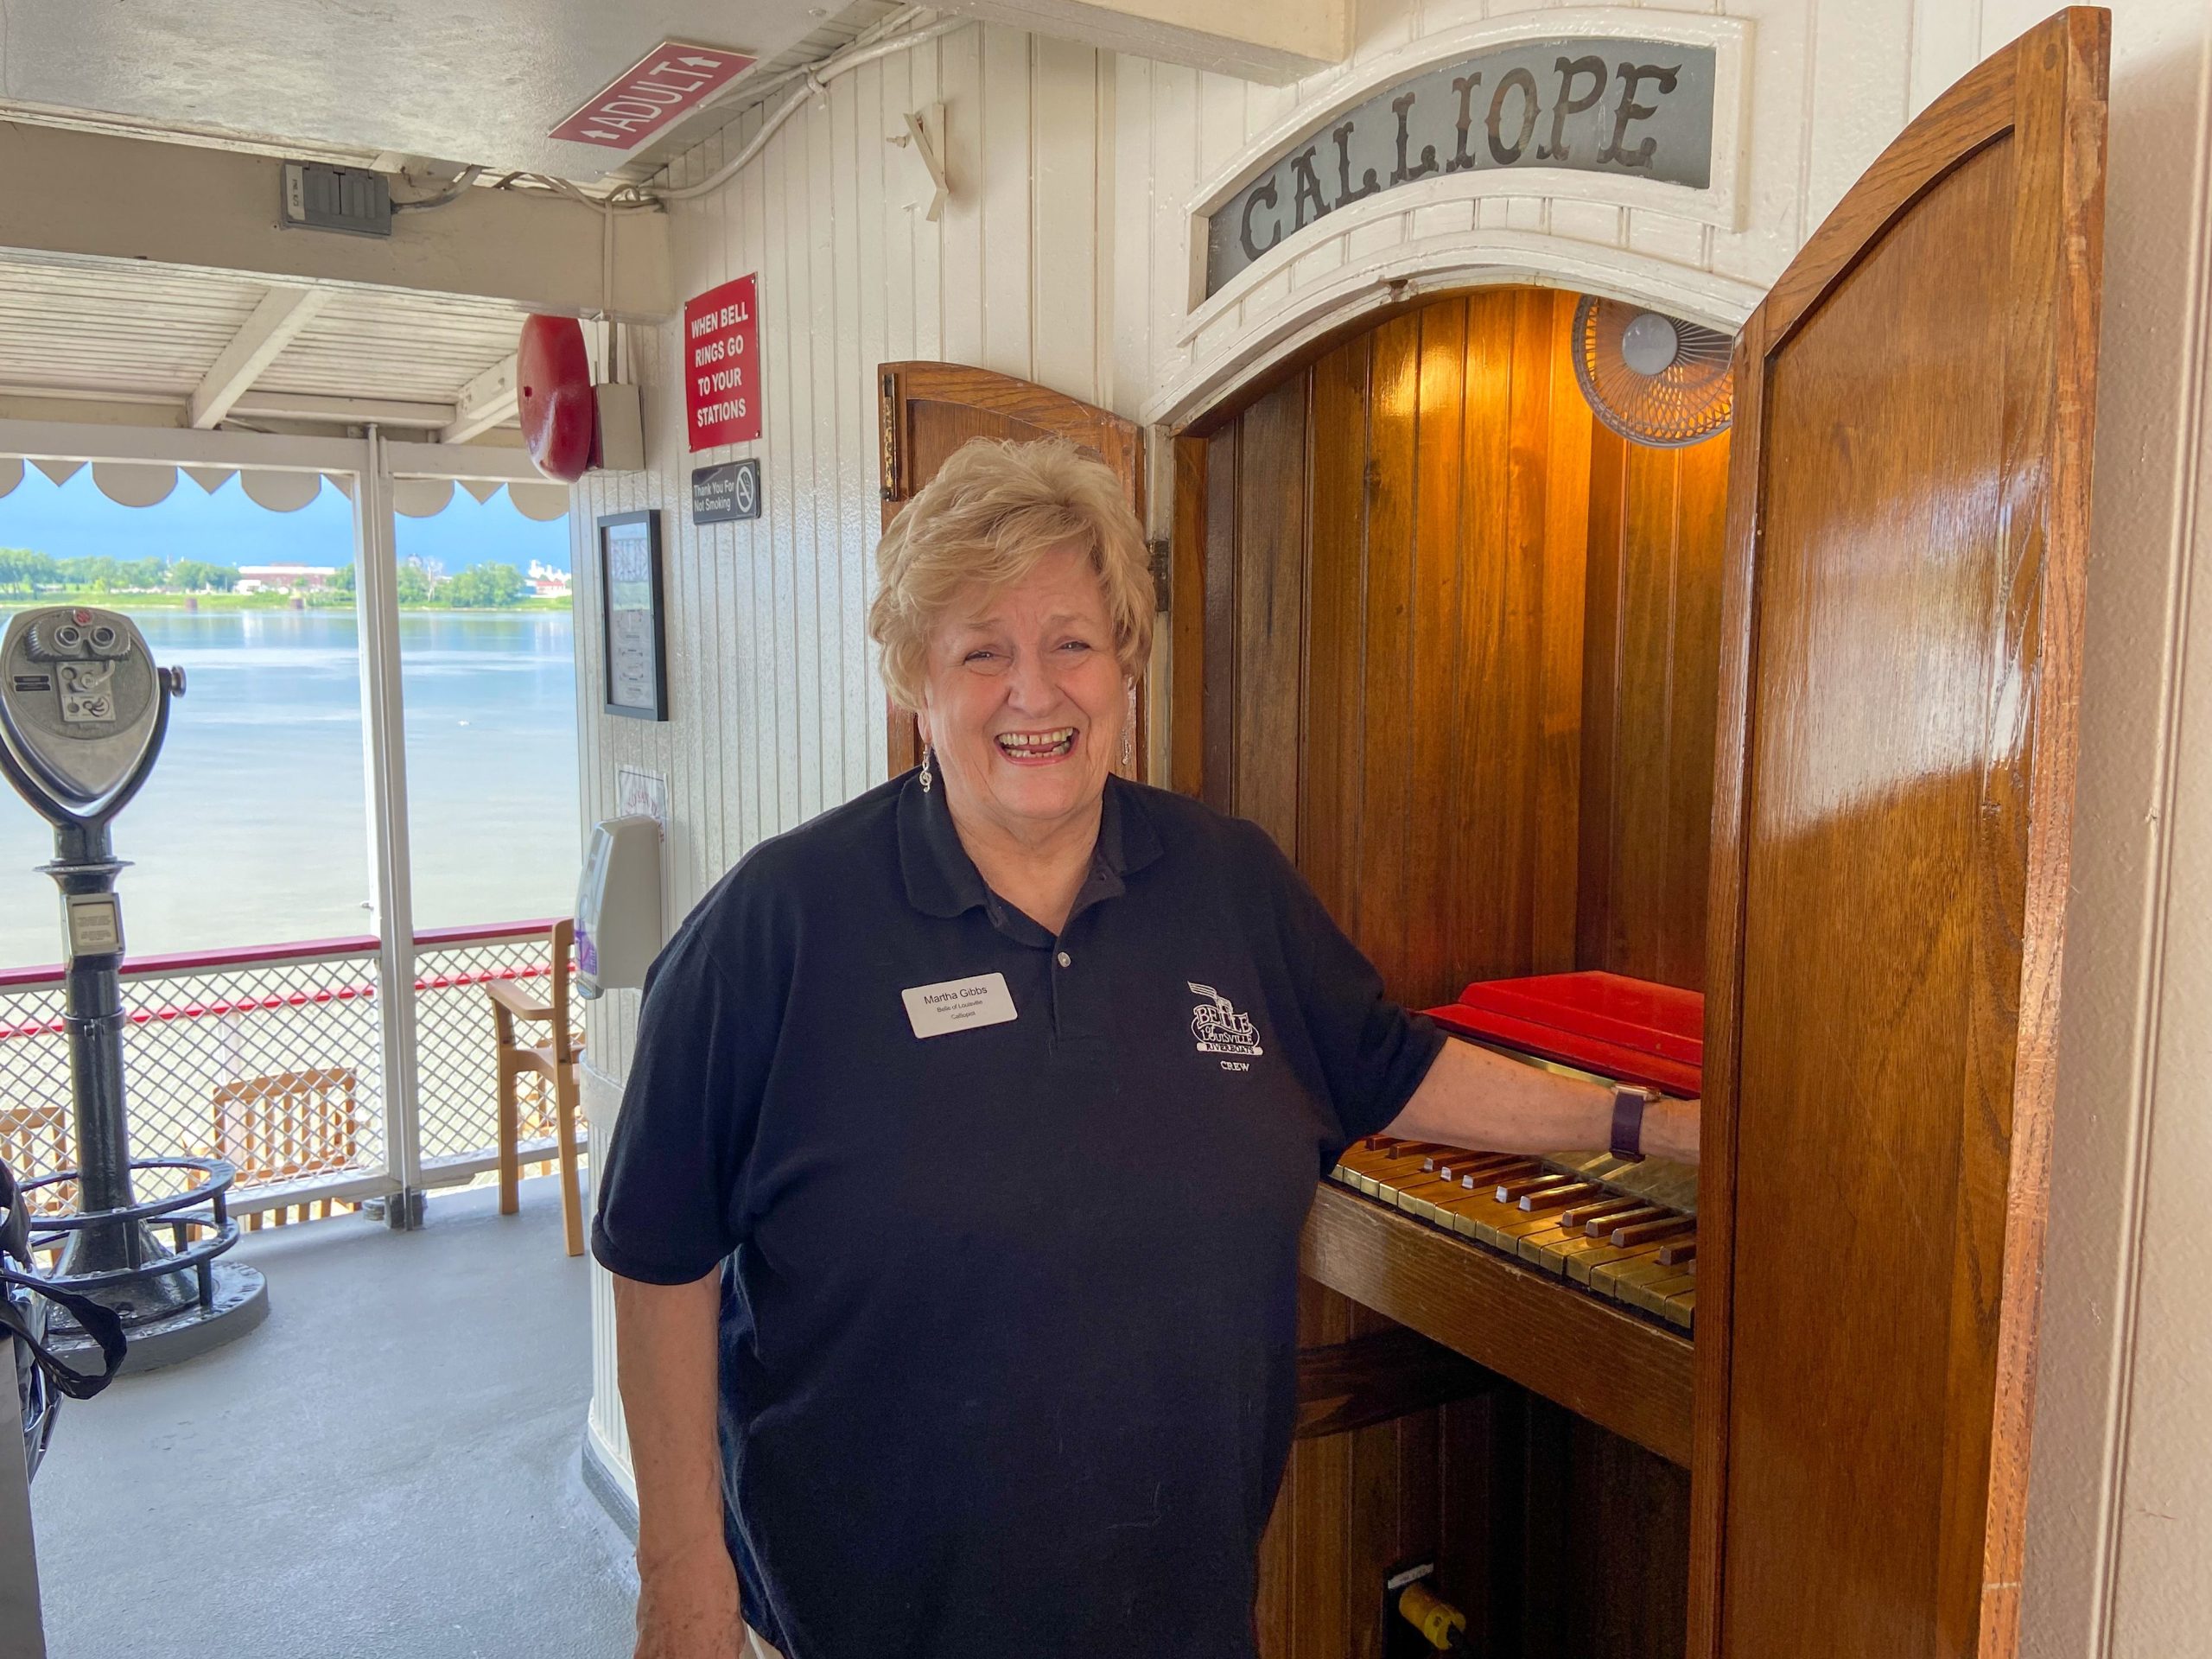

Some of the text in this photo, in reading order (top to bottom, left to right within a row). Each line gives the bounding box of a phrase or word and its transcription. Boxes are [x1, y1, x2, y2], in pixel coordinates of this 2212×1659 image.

[588, 61, 714, 132] ADULT
[1239, 54, 1683, 262] CALLIOPE
[691, 302, 749, 340] WHEN BELL
[695, 334, 744, 368] RINGS GO
[697, 367, 742, 397] TO YOUR
[696, 397, 747, 428] STATIONS
[694, 480, 734, 497] Thank You For
[694, 496, 731, 512] Not Smoking
[924, 987, 988, 1005] Martha Gibbs
[1197, 1007, 1252, 1033] BELLE
[1200, 1029, 1254, 1045] LOUISVILLE
[1206, 1043, 1255, 1054] RIVERBOATS
[1220, 1060, 1250, 1071] CREW
